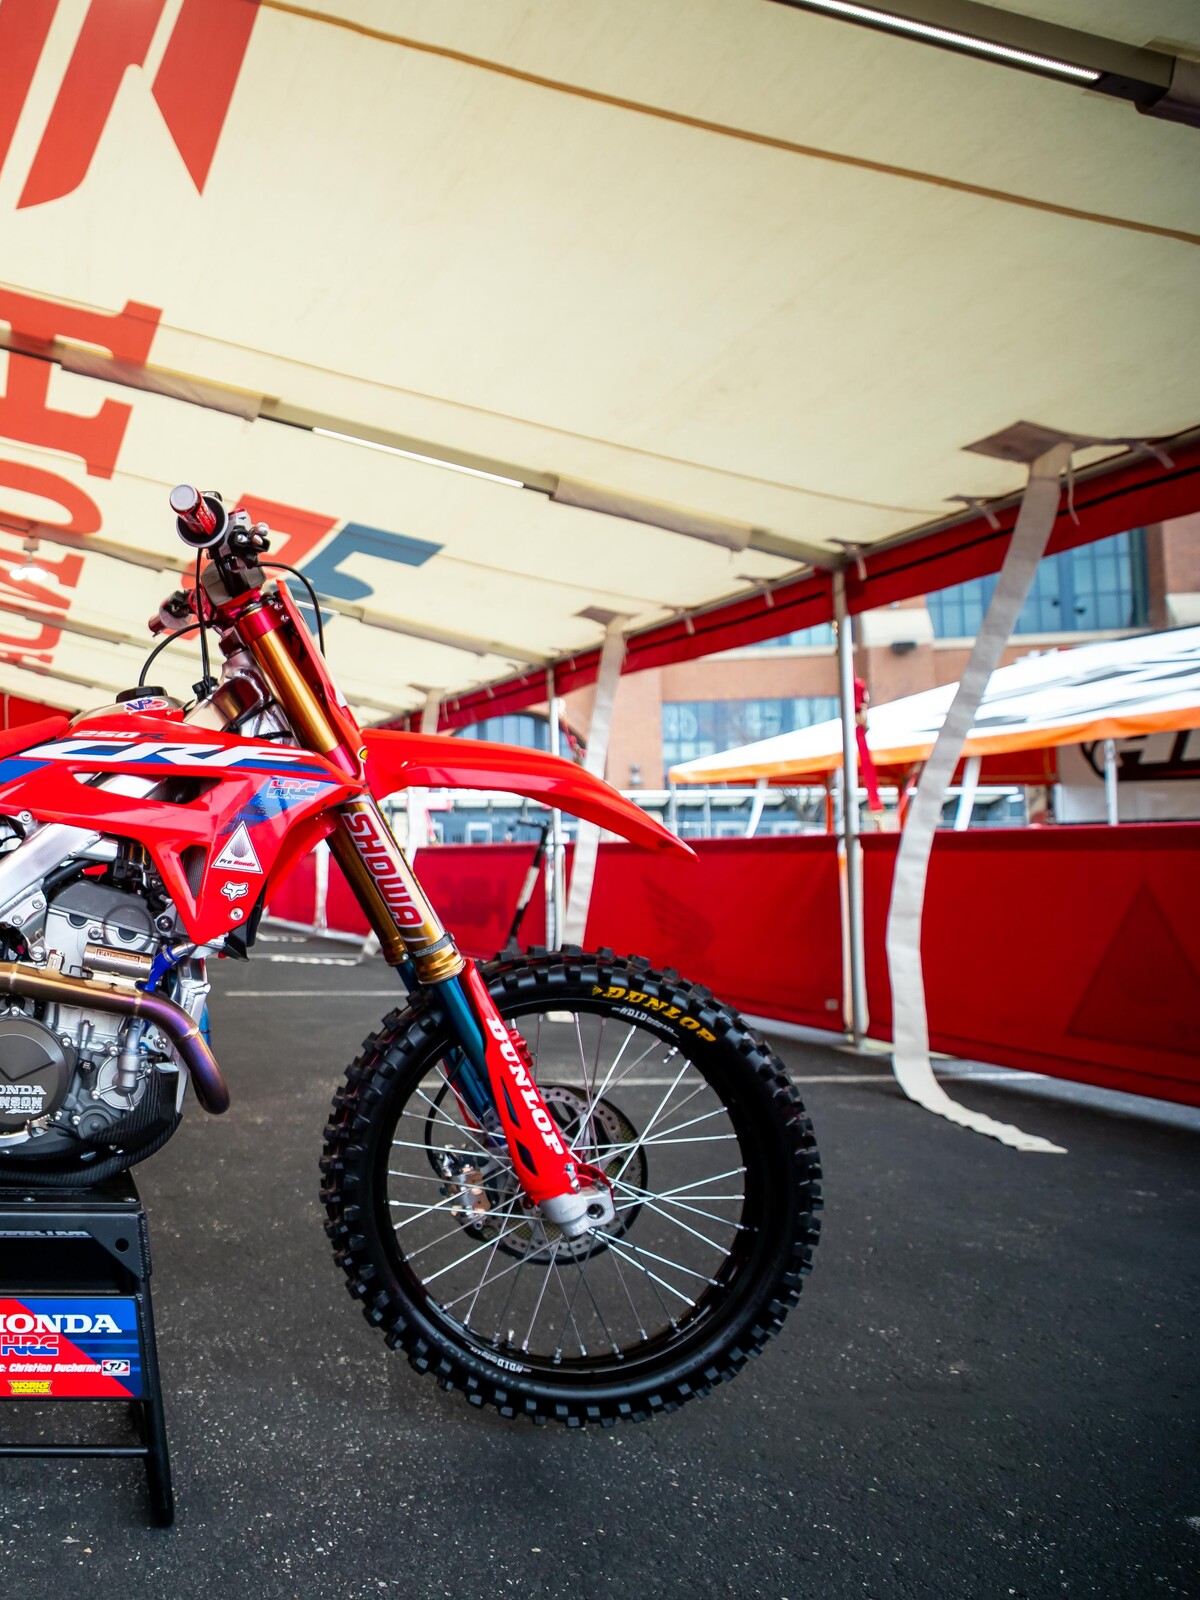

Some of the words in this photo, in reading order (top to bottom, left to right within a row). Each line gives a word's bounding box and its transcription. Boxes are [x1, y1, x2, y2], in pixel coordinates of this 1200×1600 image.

[20, 740, 316, 767] CRF
[267, 780, 321, 797] HRC
[341, 811, 425, 928] SHOWA
[602, 986, 717, 1042] DUNLOP
[486, 1017, 564, 1155] DUNLOP
[0, 1335, 59, 1356] HRC
[53, 1362, 102, 1373] Ducharme
